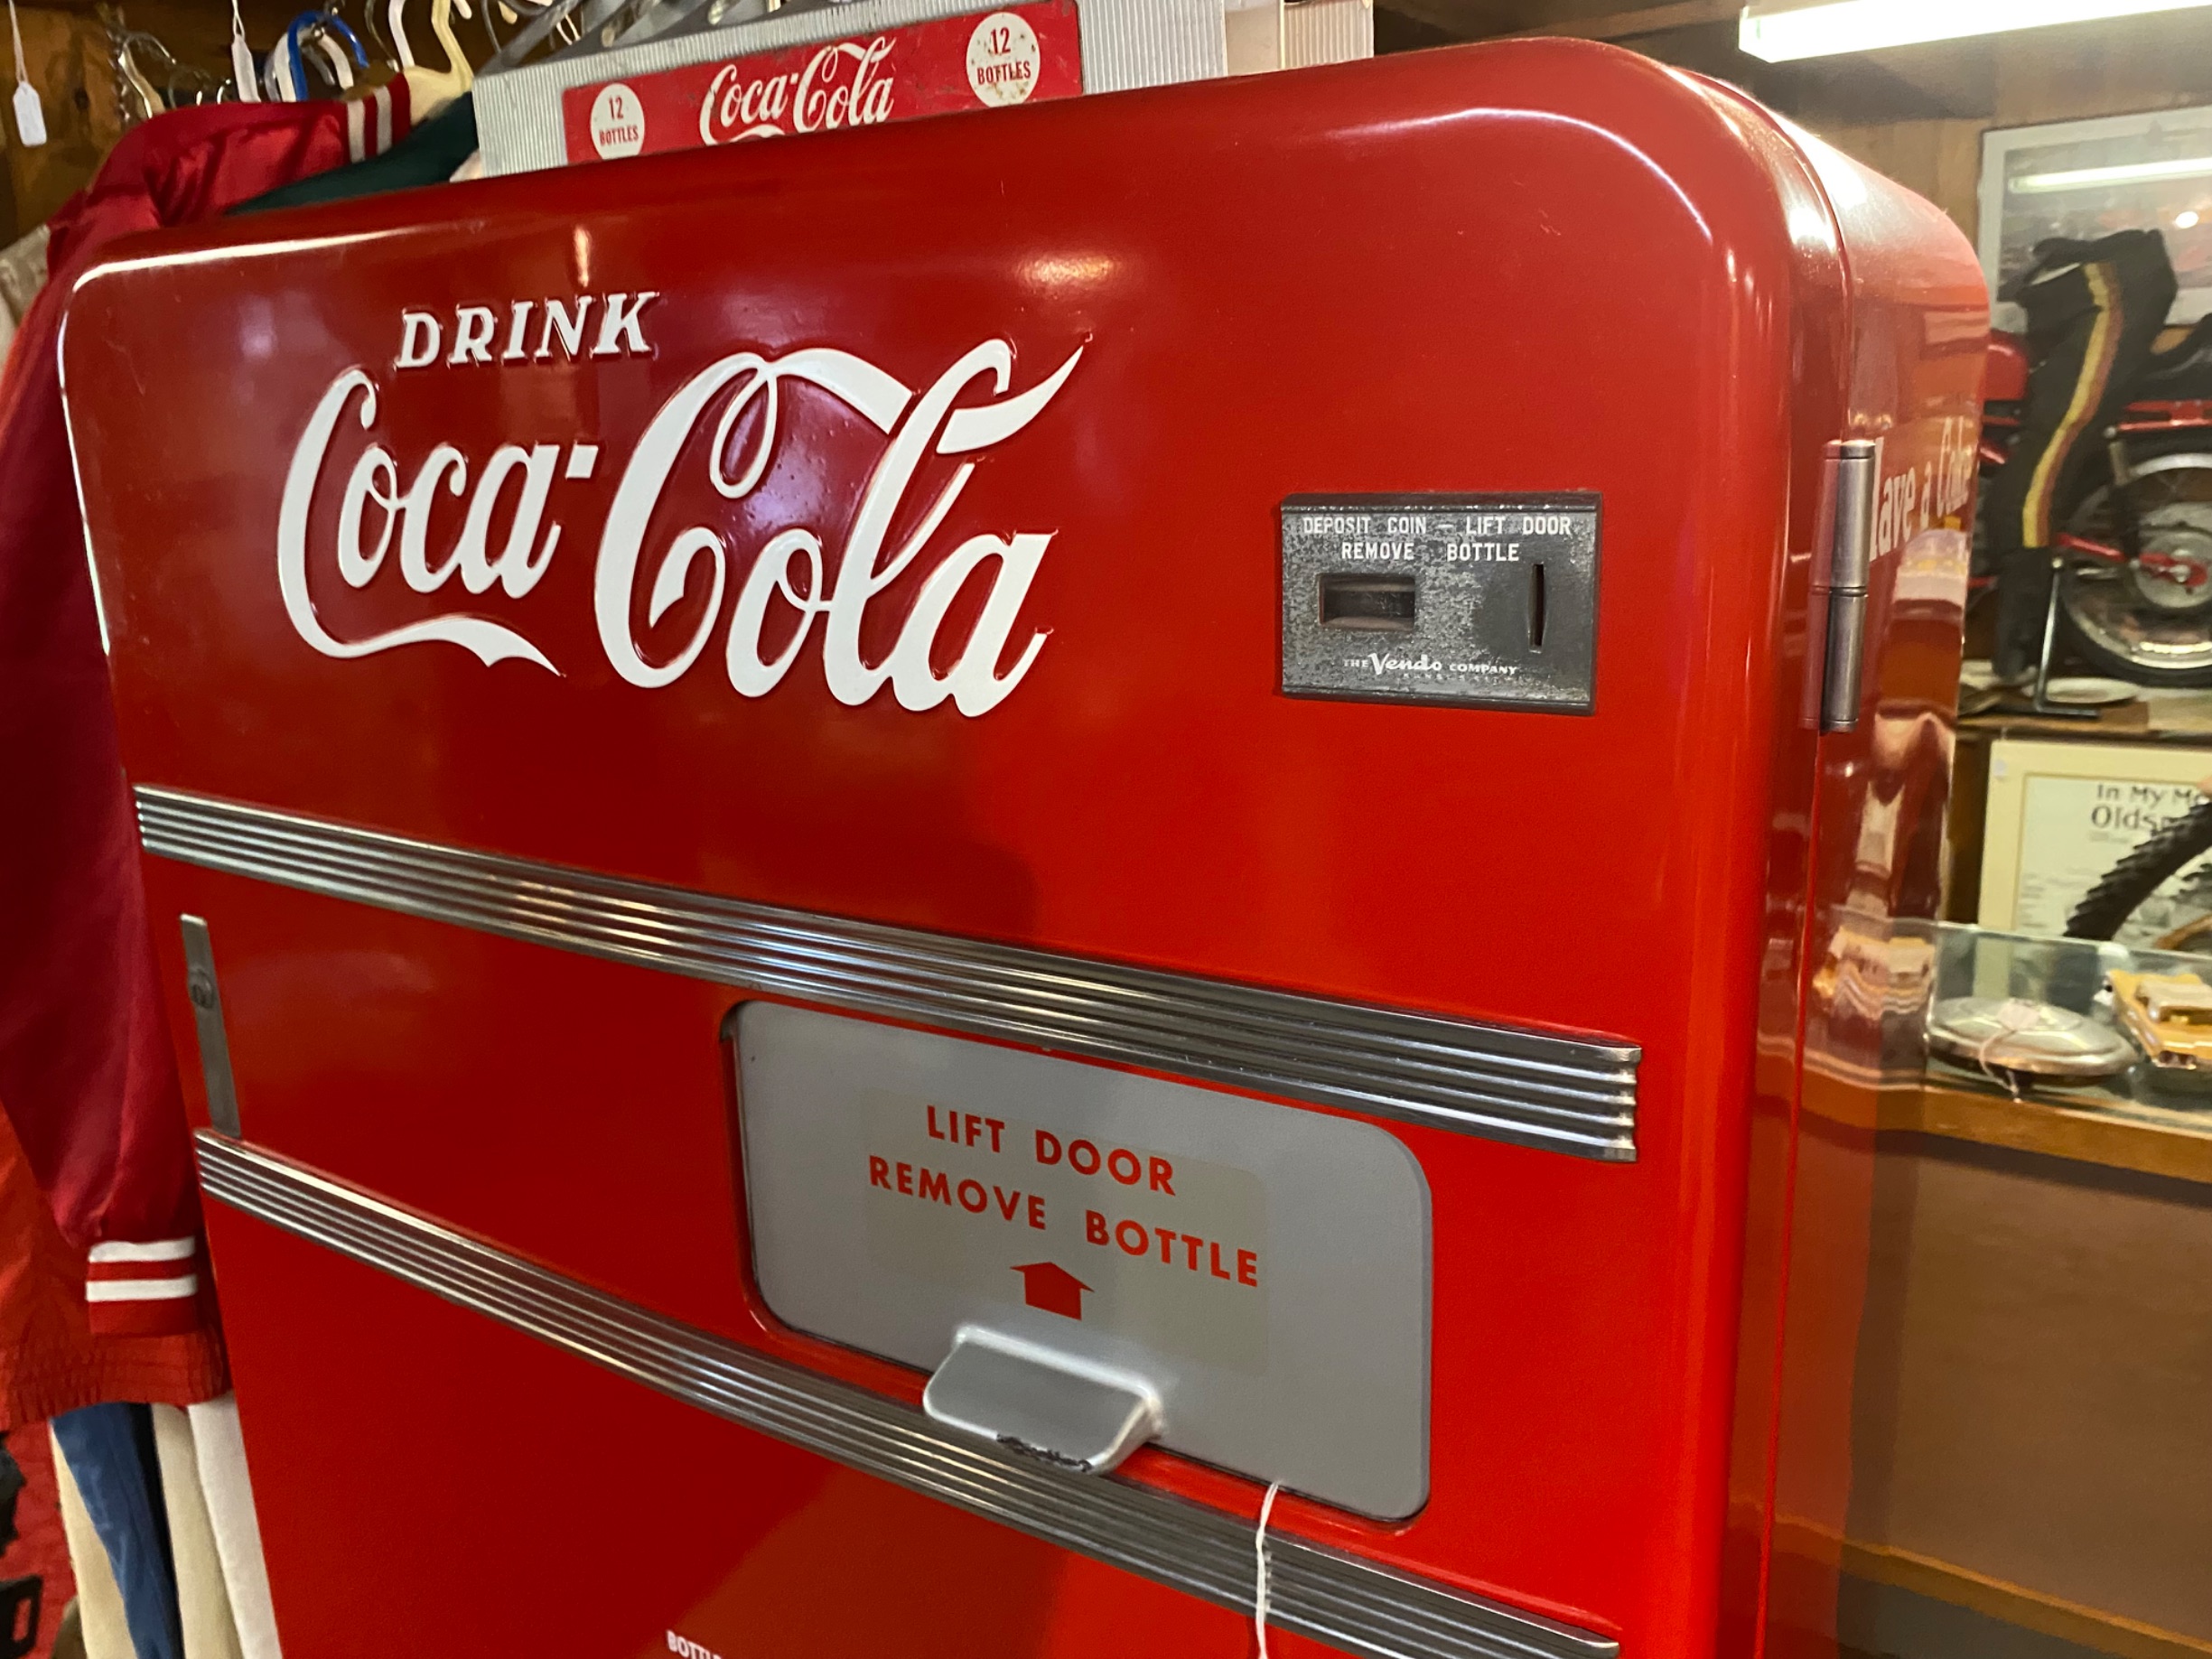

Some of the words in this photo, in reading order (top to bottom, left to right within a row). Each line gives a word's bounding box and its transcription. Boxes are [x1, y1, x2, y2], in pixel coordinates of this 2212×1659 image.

[991, 27, 1011, 54] 12
[976, 60, 1031, 85] BOTTLES
[700, 36, 896, 145] Coca-Cola
[609, 96, 624, 119] 12
[599, 126, 639, 146] BOTTLES
[395, 291, 659, 370] DRINK
[277, 338, 1087, 718] Coca-Cola
[1302, 516, 1371, 535] DEPOSIT
[1387, 516, 1427, 535] COIN
[1465, 516, 1506, 535] LIFT
[1522, 516, 1572, 536] DOOR
[1341, 542, 1414, 560] REMOVE
[1446, 542, 1520, 562] BOTTLE
[1343, 658, 1368, 669] THE
[1367, 652, 1442, 676] Vendo
[1449, 663, 1518, 675] COMPANY
[2097, 784, 2120, 799] In
[926, 1104, 1005, 1153] LIFT
[1035, 1129, 1176, 1197] DOOR
[868, 1154, 1046, 1230] REMOVE
[1085, 1209, 1258, 1288] BOTTLE
